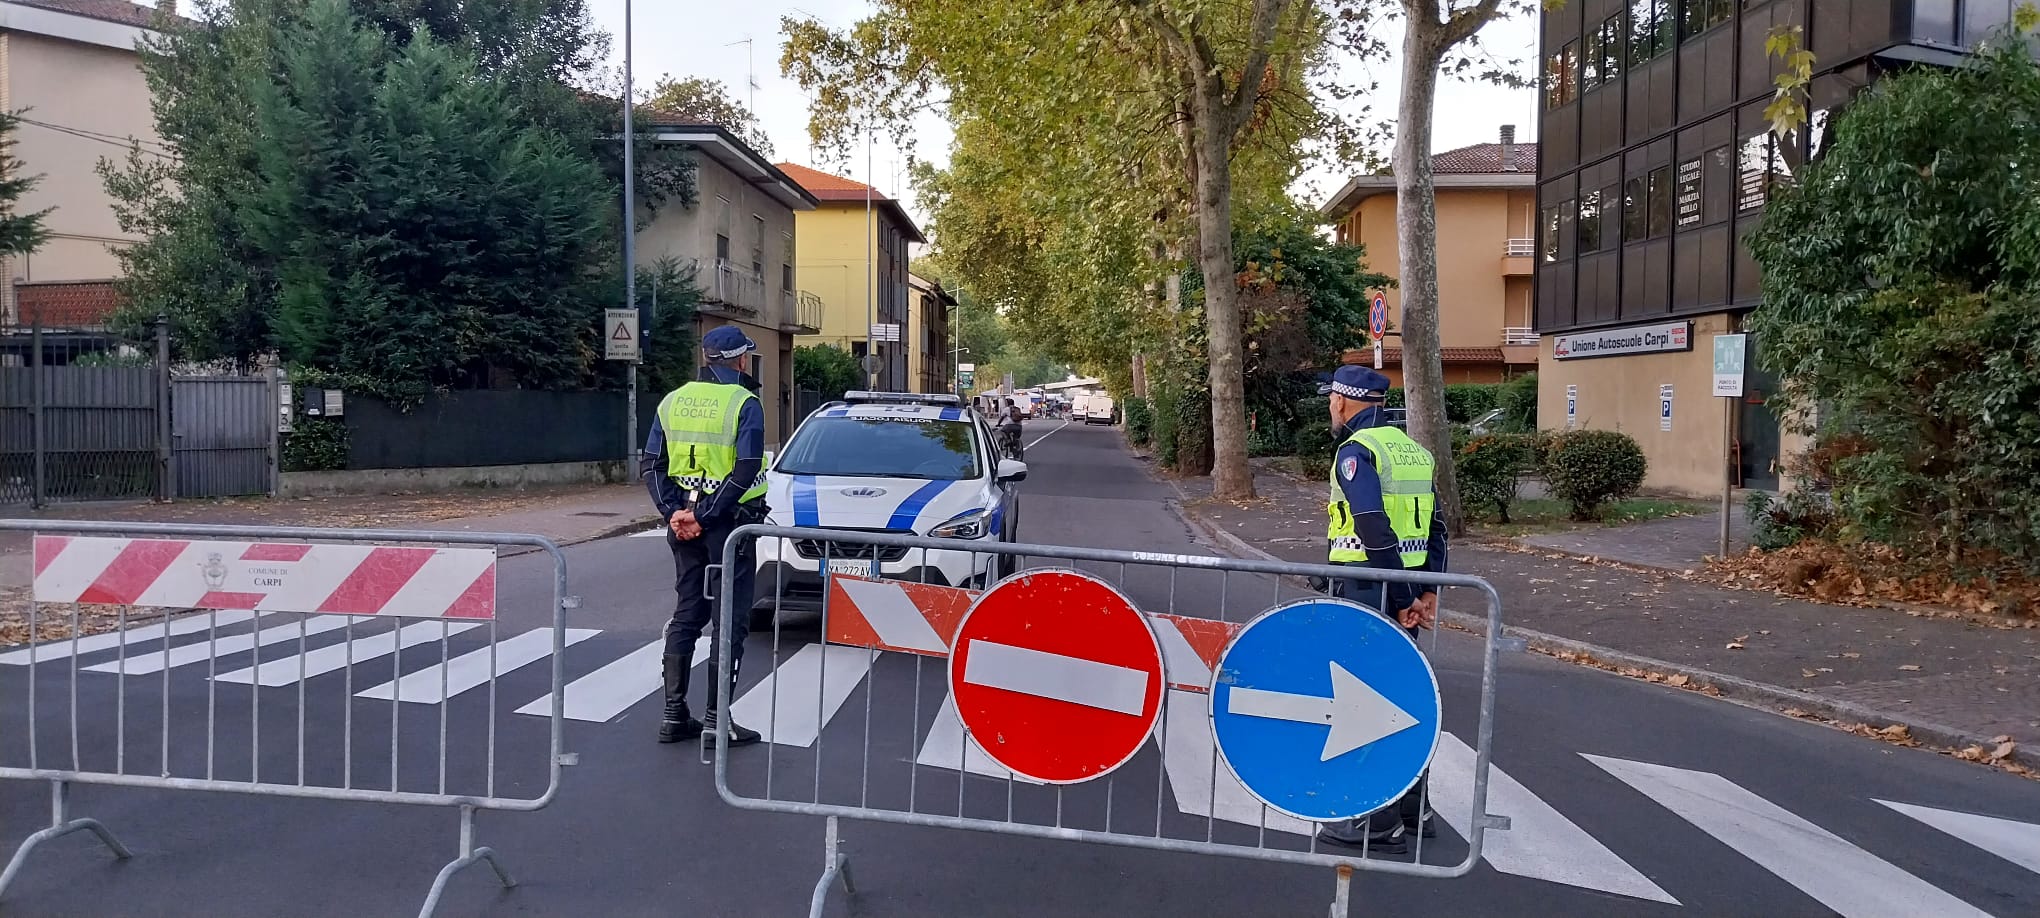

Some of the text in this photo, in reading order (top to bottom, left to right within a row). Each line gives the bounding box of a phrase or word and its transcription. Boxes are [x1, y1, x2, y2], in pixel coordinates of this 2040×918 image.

[1680, 160, 1700, 173] STUDIO
[1680, 171, 1701, 183] LEGALE
[1679, 192, 1700, 204] MARZIA
[1572, 331, 1669, 352] Unione Autoscuole Carpi
[676, 396, 719, 408] POLIZIA
[673, 407, 718, 419] LOCALE
[281, 414, 289, 425] 3
[1392, 454, 1430, 466] LOCALE
[248, 567, 288, 576] COMUNE DI
[254, 577, 282, 586] CARPI
